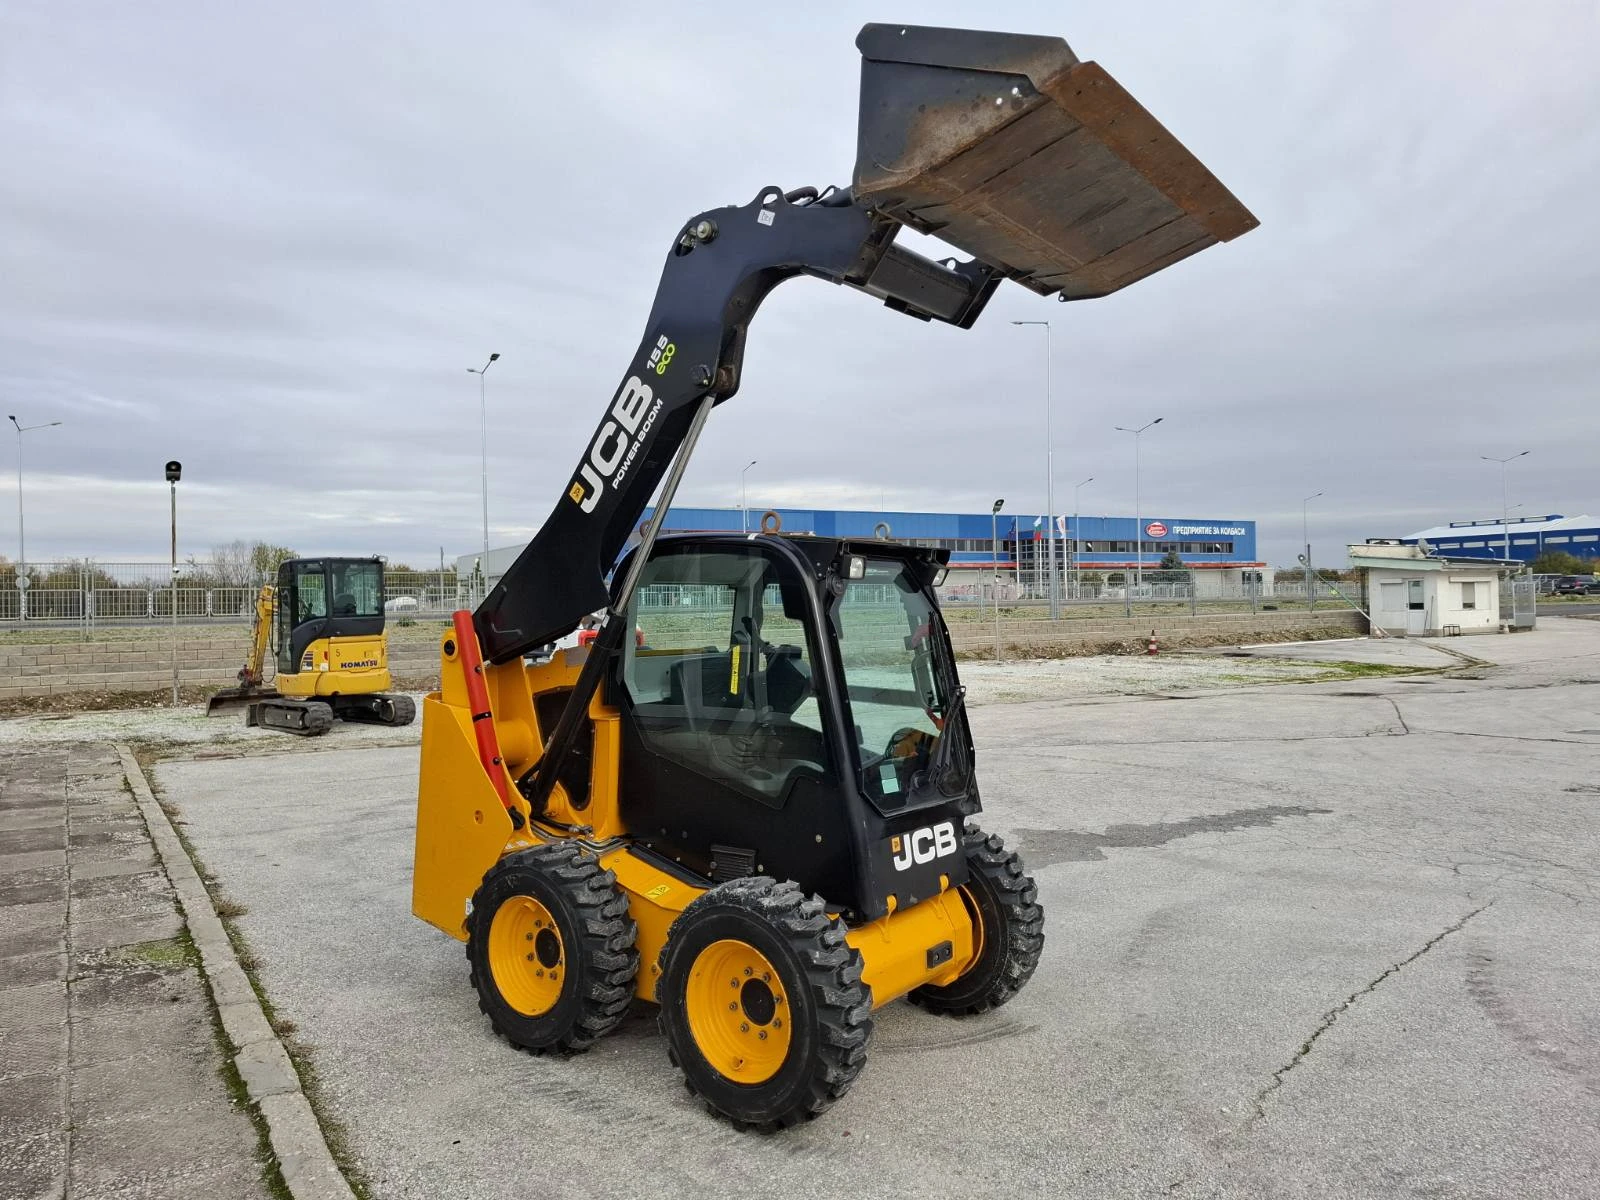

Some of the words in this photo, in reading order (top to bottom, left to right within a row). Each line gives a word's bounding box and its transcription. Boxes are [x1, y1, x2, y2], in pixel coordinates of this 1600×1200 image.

[647, 334, 668, 369] 155
[656, 343, 676, 375] eco
[580, 375, 653, 514] JCB
[340, 660, 378, 669] KOMATSU
[893, 821, 957, 872] JCB
